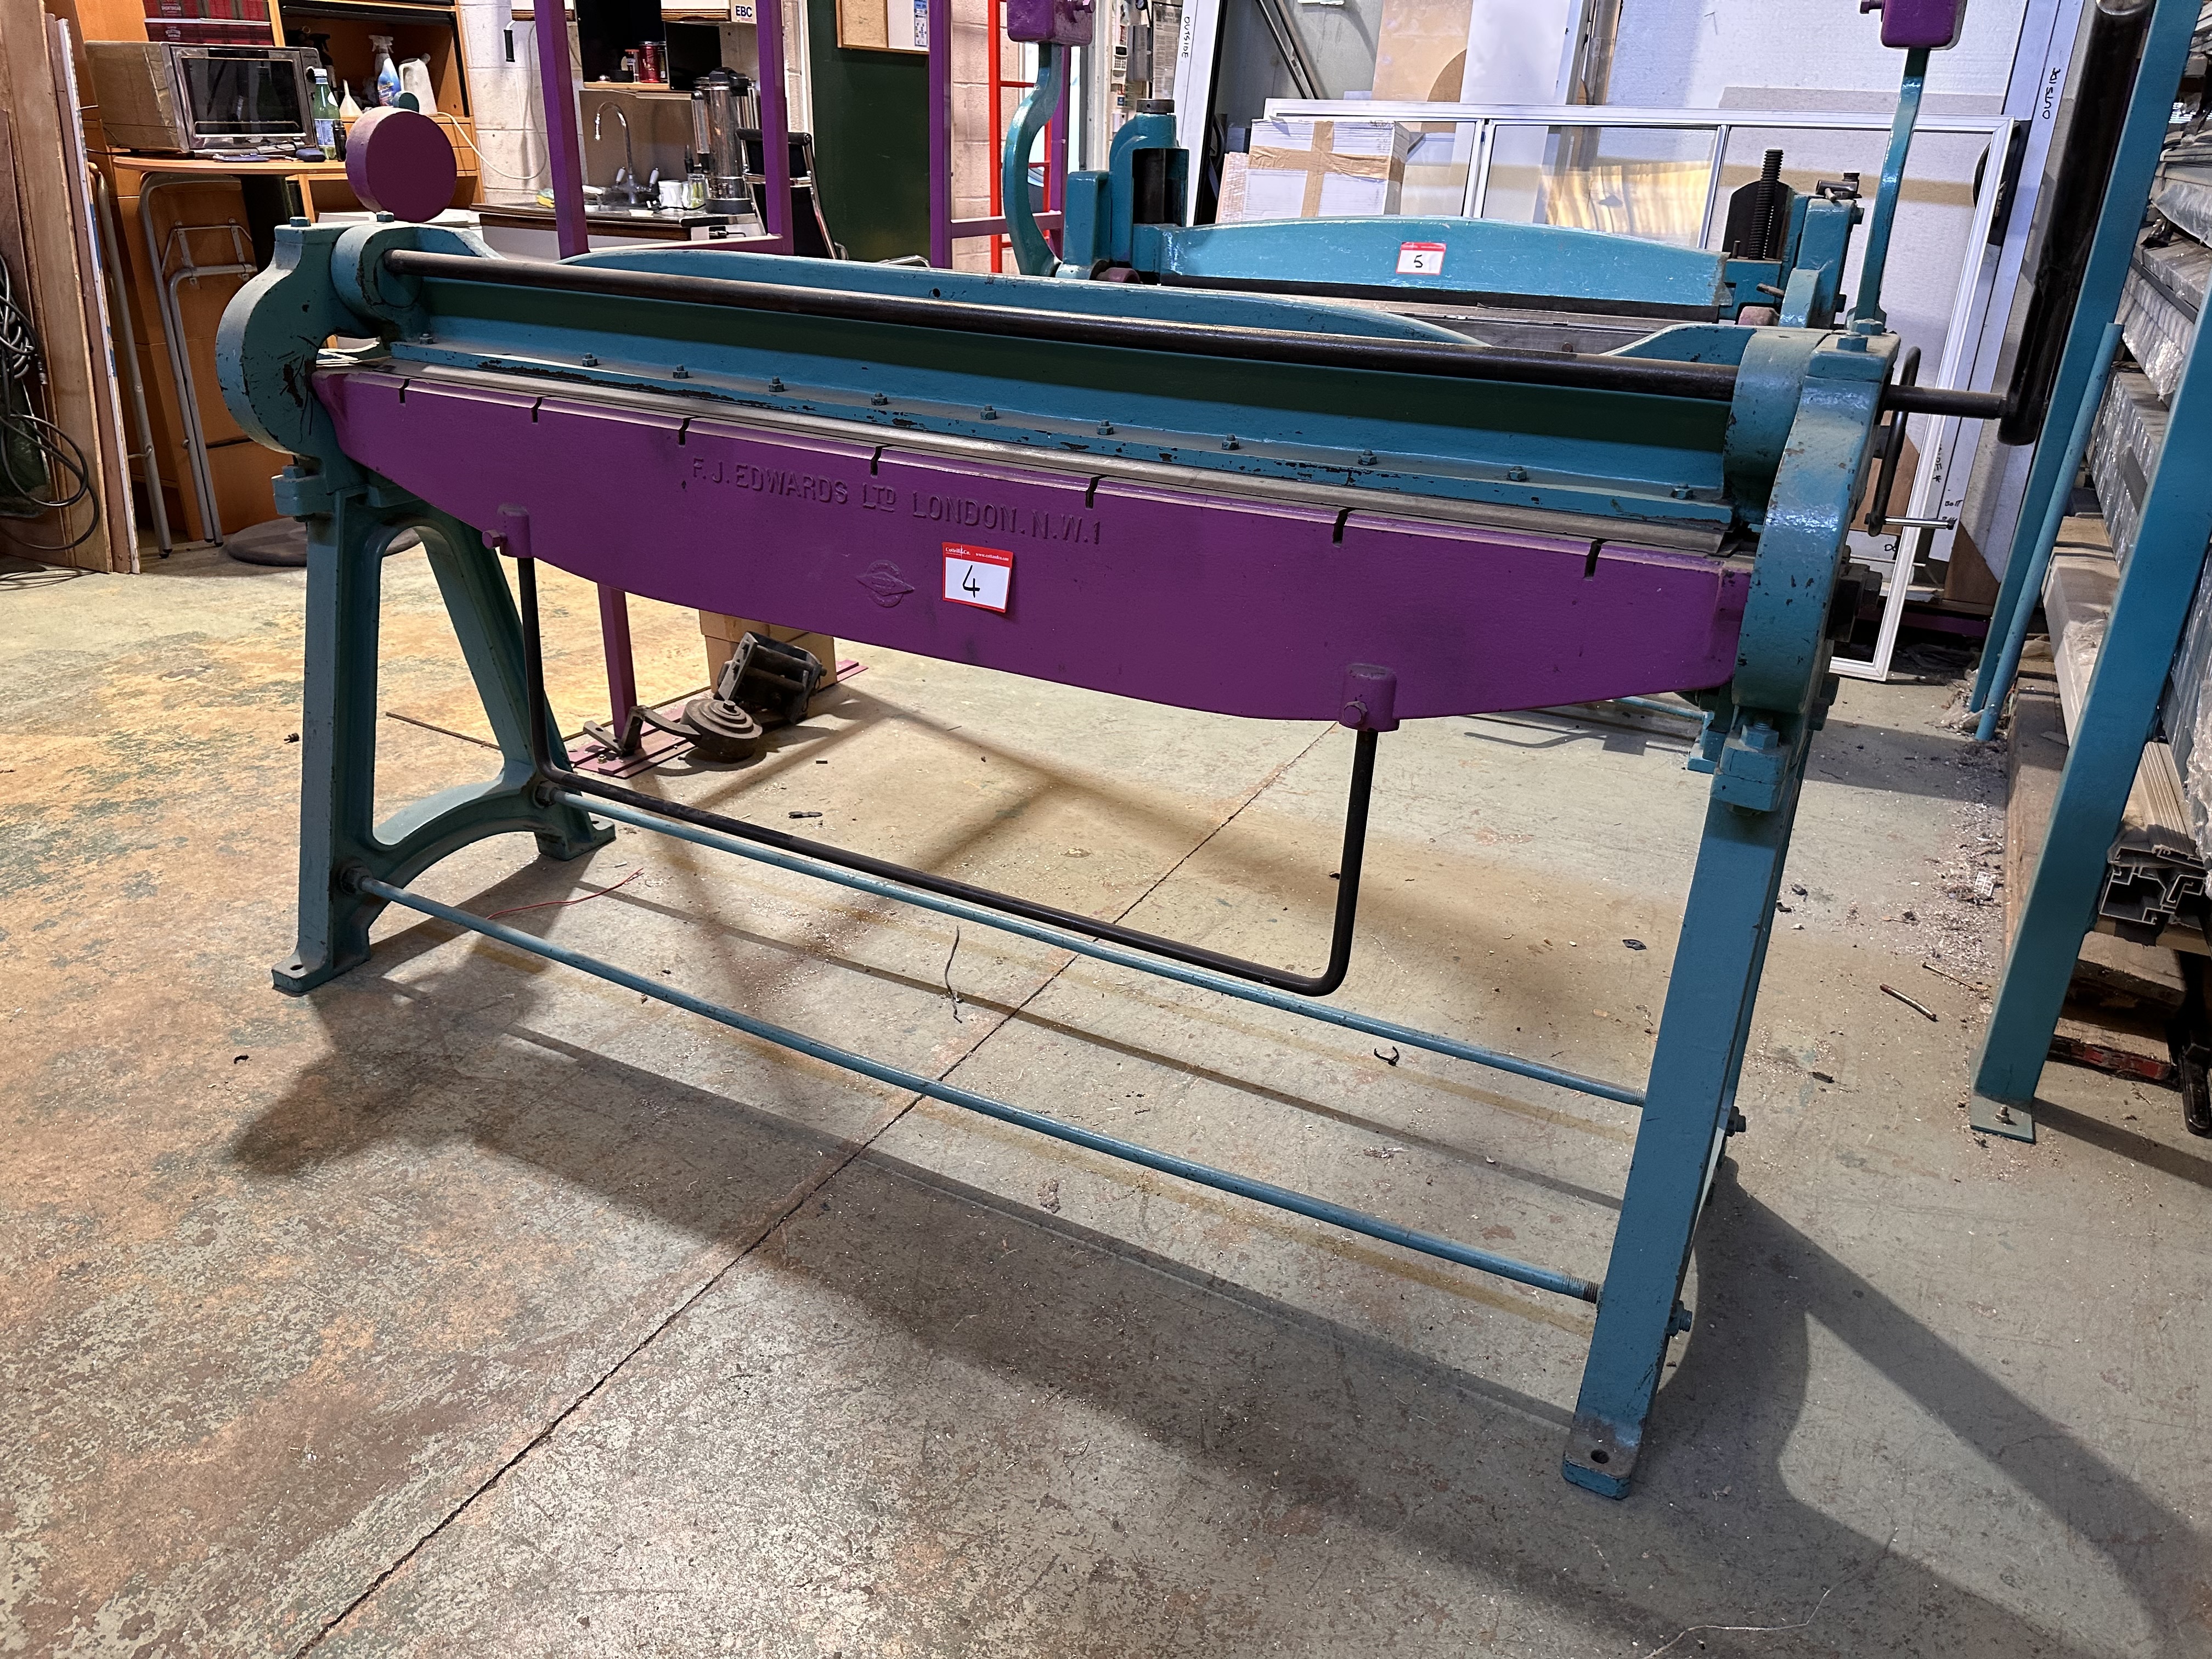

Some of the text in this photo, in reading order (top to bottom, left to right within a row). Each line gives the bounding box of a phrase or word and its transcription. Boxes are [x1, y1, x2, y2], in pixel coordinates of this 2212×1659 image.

[736, 5, 752, 18] EBC
[1181, 16, 1190, 58] OUTSIDE
[2042, 67, 2061, 119] OUTSIDE
[1413, 254, 1424, 268] 5
[962, 565, 980, 599] 4
